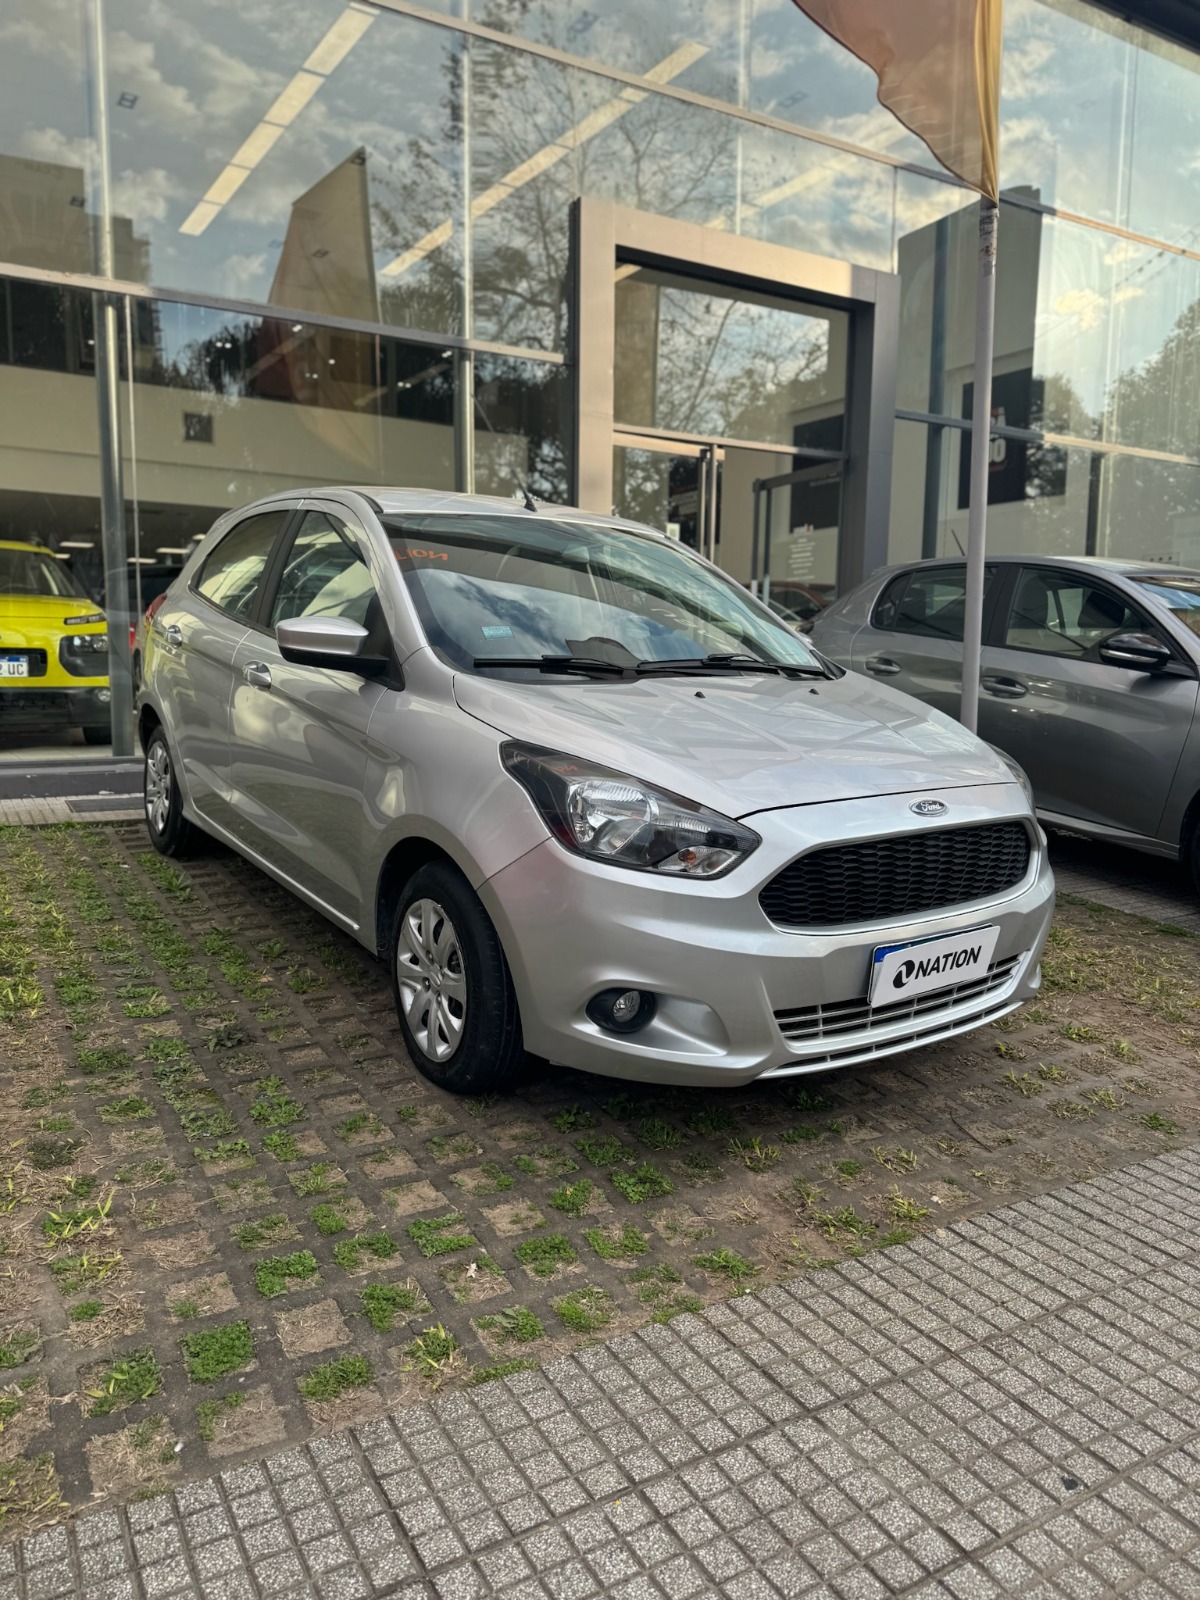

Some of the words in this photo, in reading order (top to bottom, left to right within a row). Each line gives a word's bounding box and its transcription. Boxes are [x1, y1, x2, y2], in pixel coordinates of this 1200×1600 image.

[8, 663, 24, 676] UC
[920, 800, 944, 812] Ford
[914, 945, 982, 980] NATION
